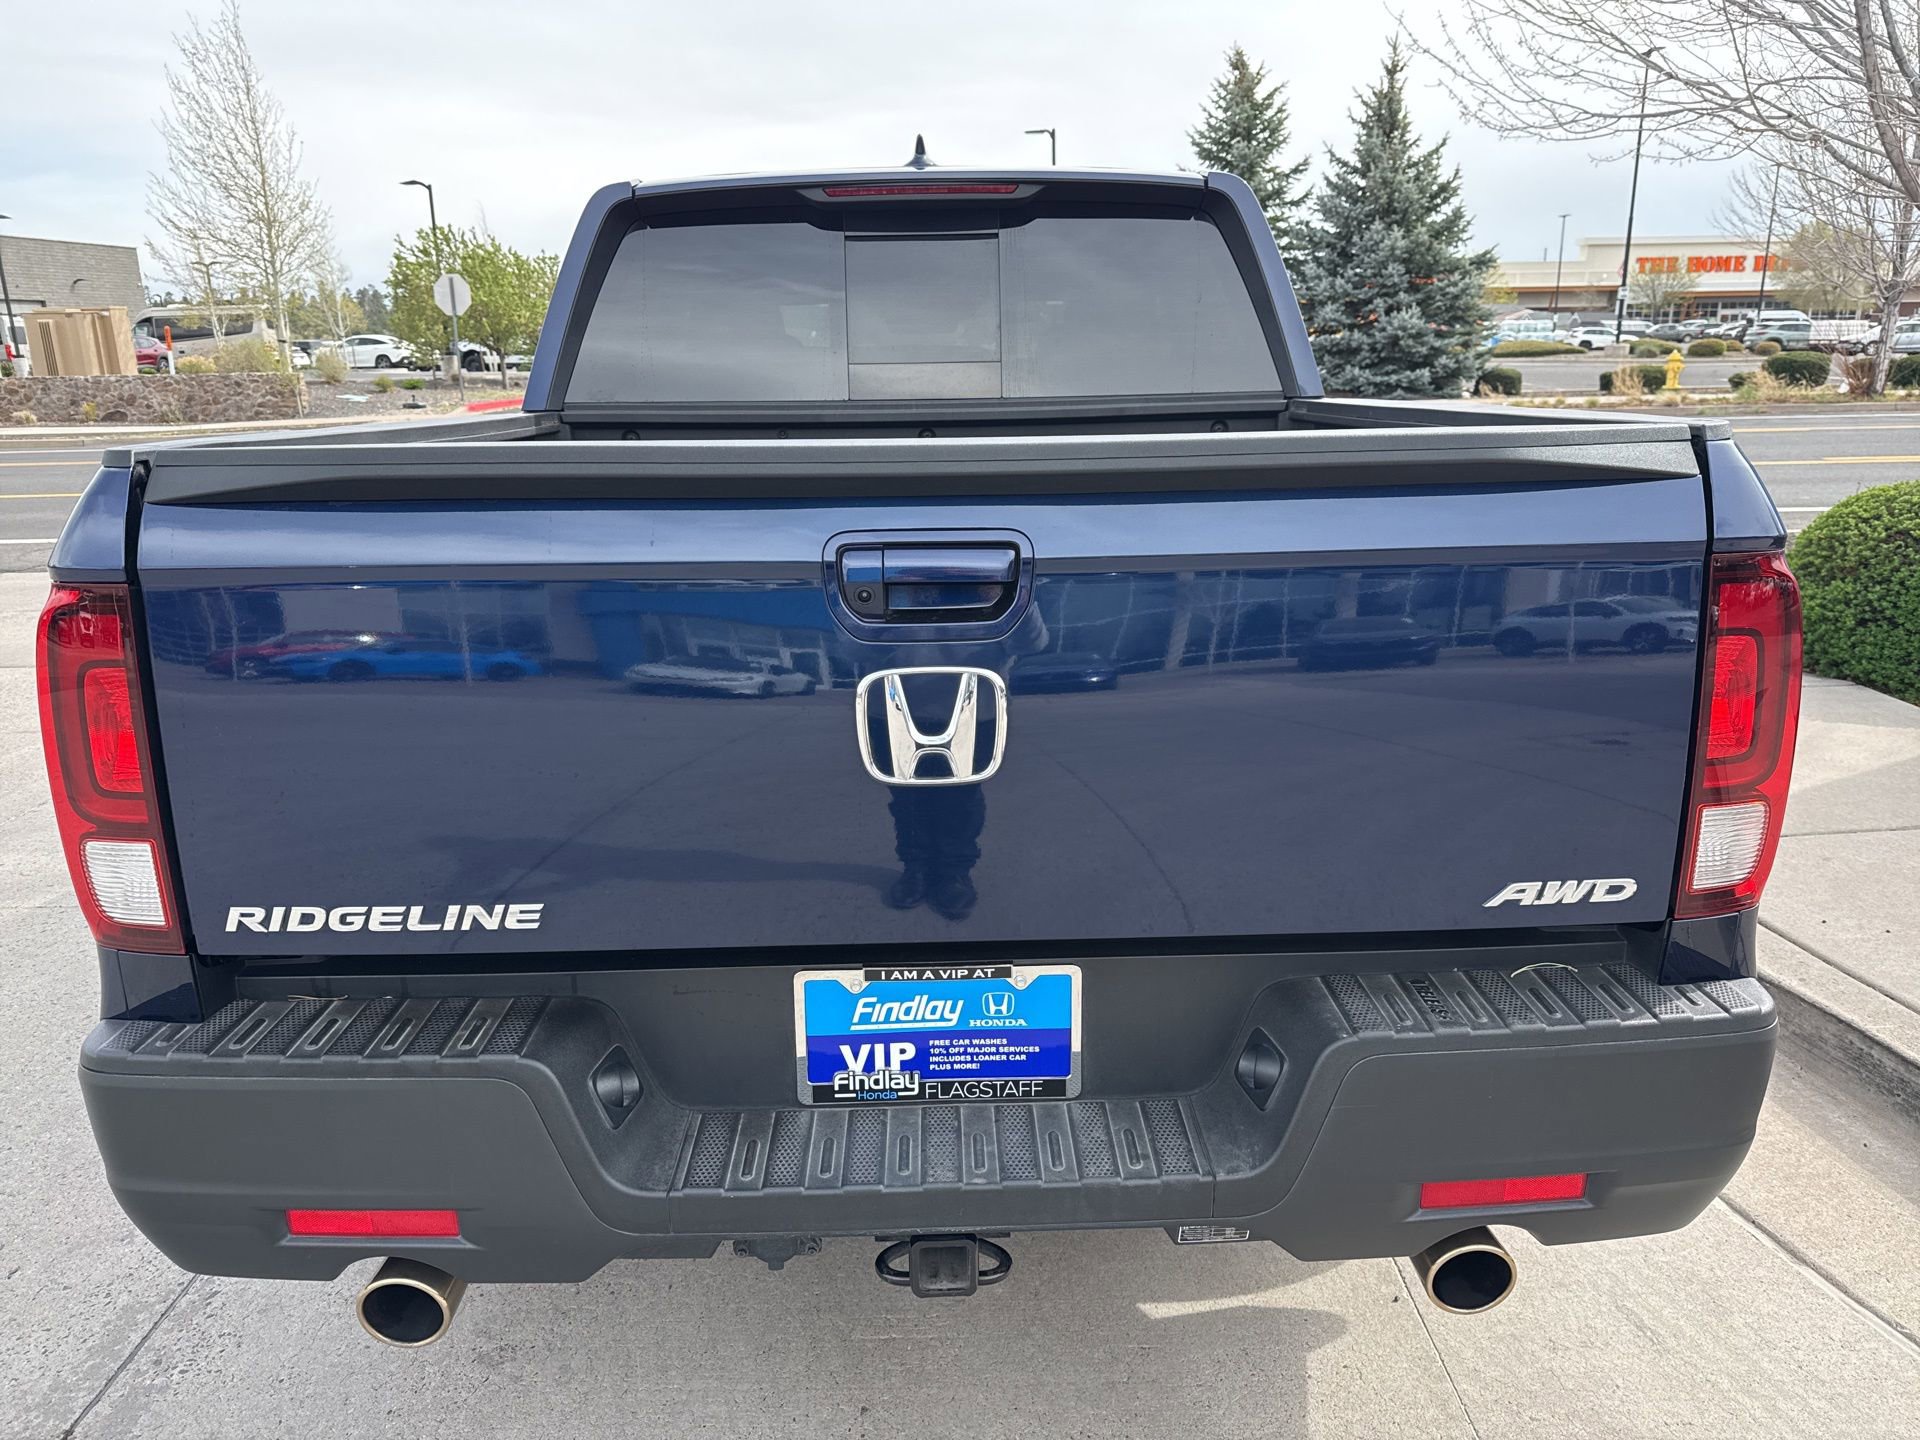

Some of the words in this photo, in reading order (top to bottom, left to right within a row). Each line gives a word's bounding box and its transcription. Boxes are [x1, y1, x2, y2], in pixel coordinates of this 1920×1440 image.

[1636, 256, 1680, 273] THE
[1687, 255, 1747, 273] HOME
[1482, 878, 1638, 907] AWD
[225, 903, 545, 932] RIDGELINE
[881, 970, 886, 980] I
[890, 970, 922, 980] AM
[922, 970, 936, 980] A
[939, 969, 969, 979] VIP
[972, 968, 995, 978] AT
[850, 995, 964, 1030] Findlay
[969, 1019, 1028, 1027] HONDA
[839, 1042, 916, 1075] VIP
[929, 1047, 947, 1055] 10%
[929, 1063, 951, 1071] PLUS
[953, 1062, 980, 1070] MORE!
[833, 1070, 919, 1098] Findlay
[925, 1080, 1044, 1098] FLAGSTAFF
[857, 1090, 898, 1100] Honda
